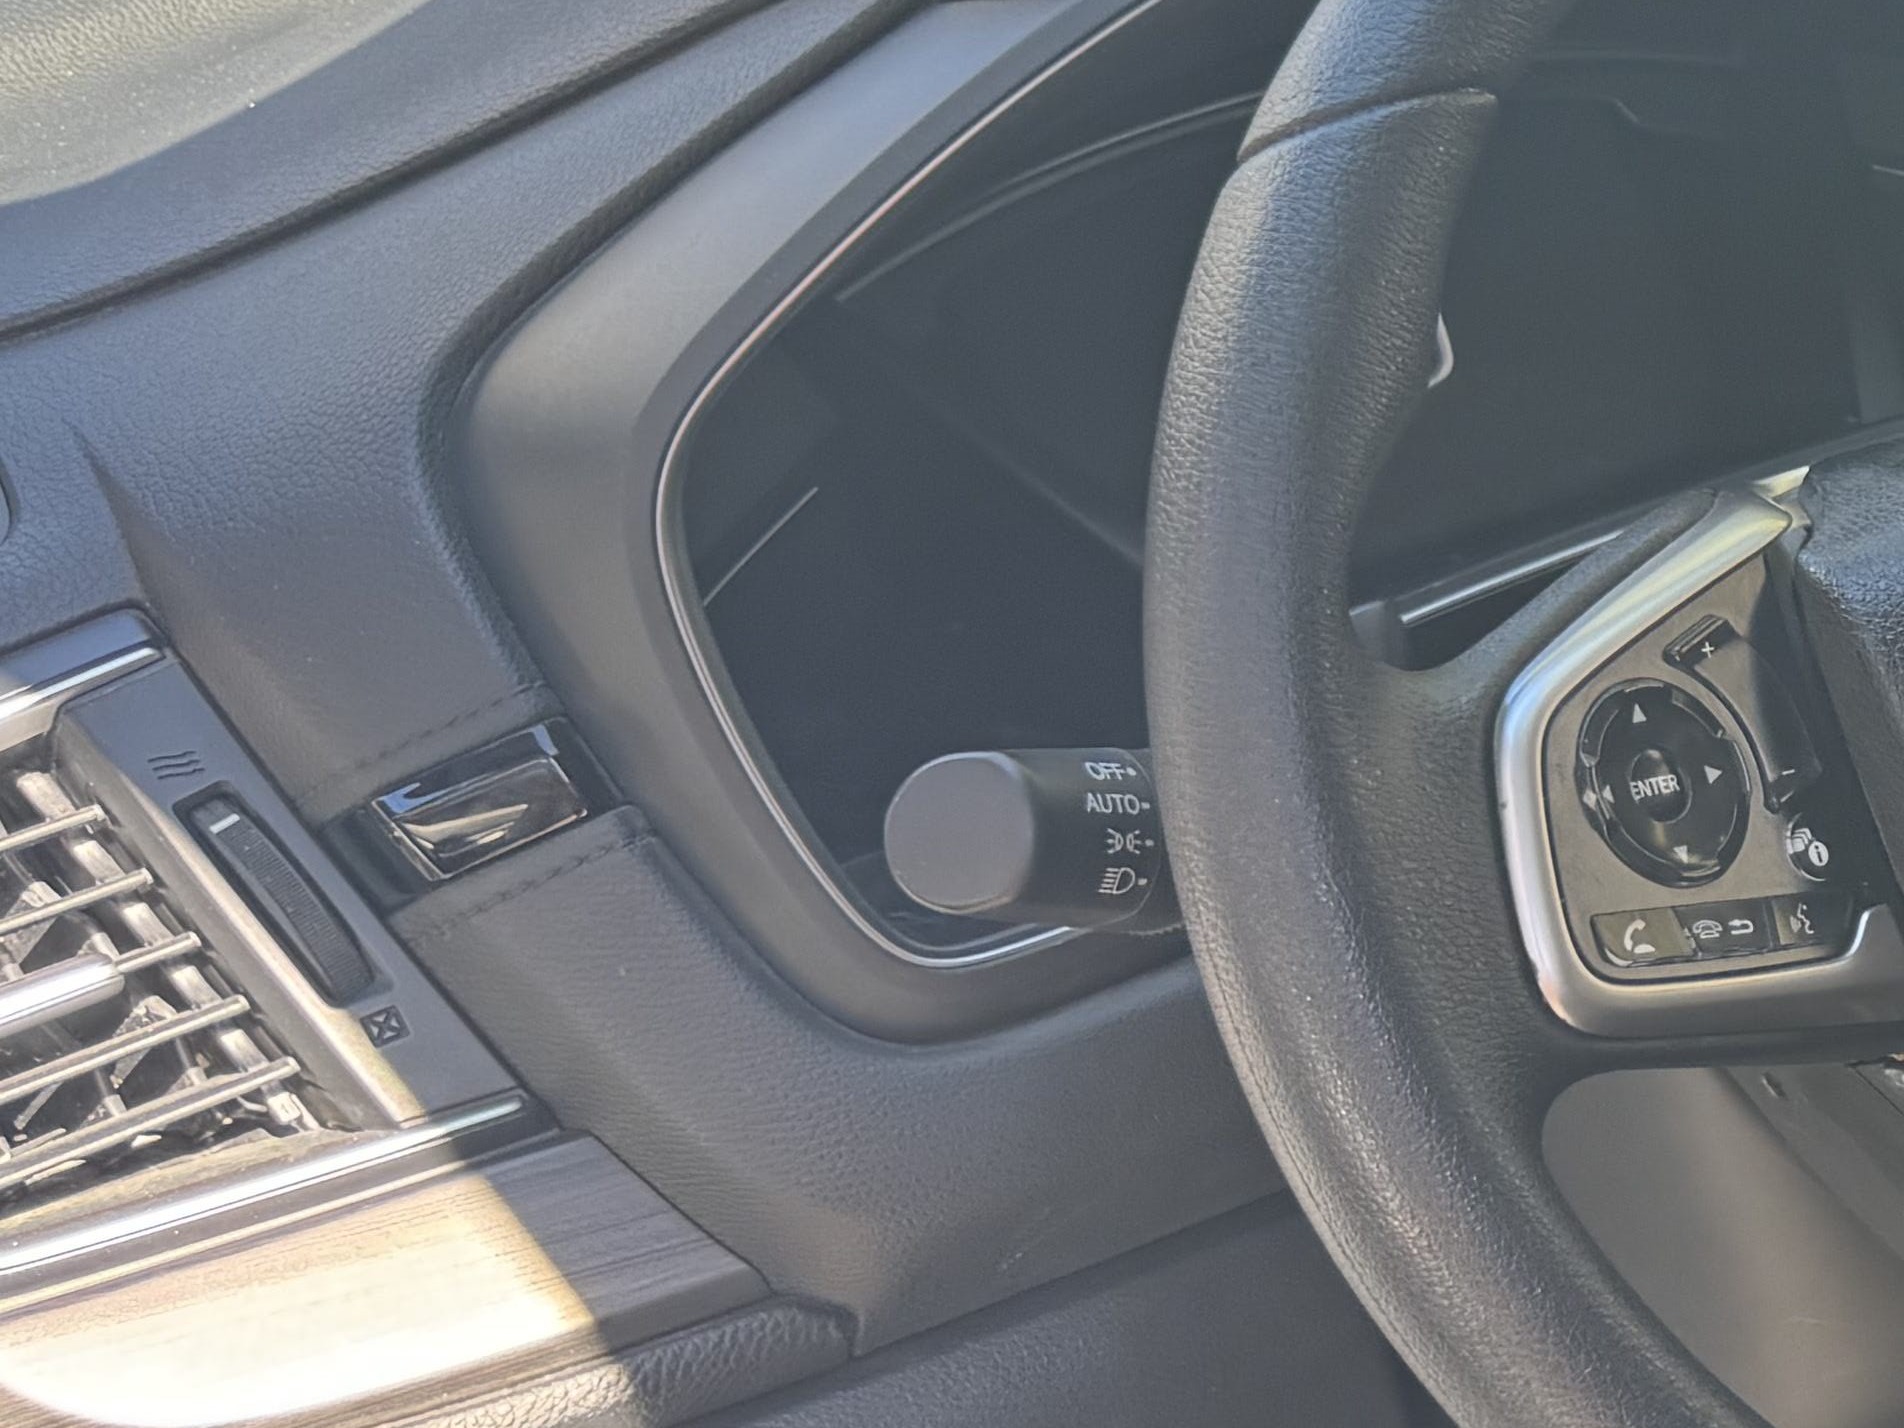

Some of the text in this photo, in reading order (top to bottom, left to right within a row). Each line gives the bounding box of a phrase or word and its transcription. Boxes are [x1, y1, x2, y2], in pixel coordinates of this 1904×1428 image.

[1085, 762, 1124, 780] OFF
[1630, 773, 1680, 802] ENTER
[1086, 792, 1140, 815] AUTO
